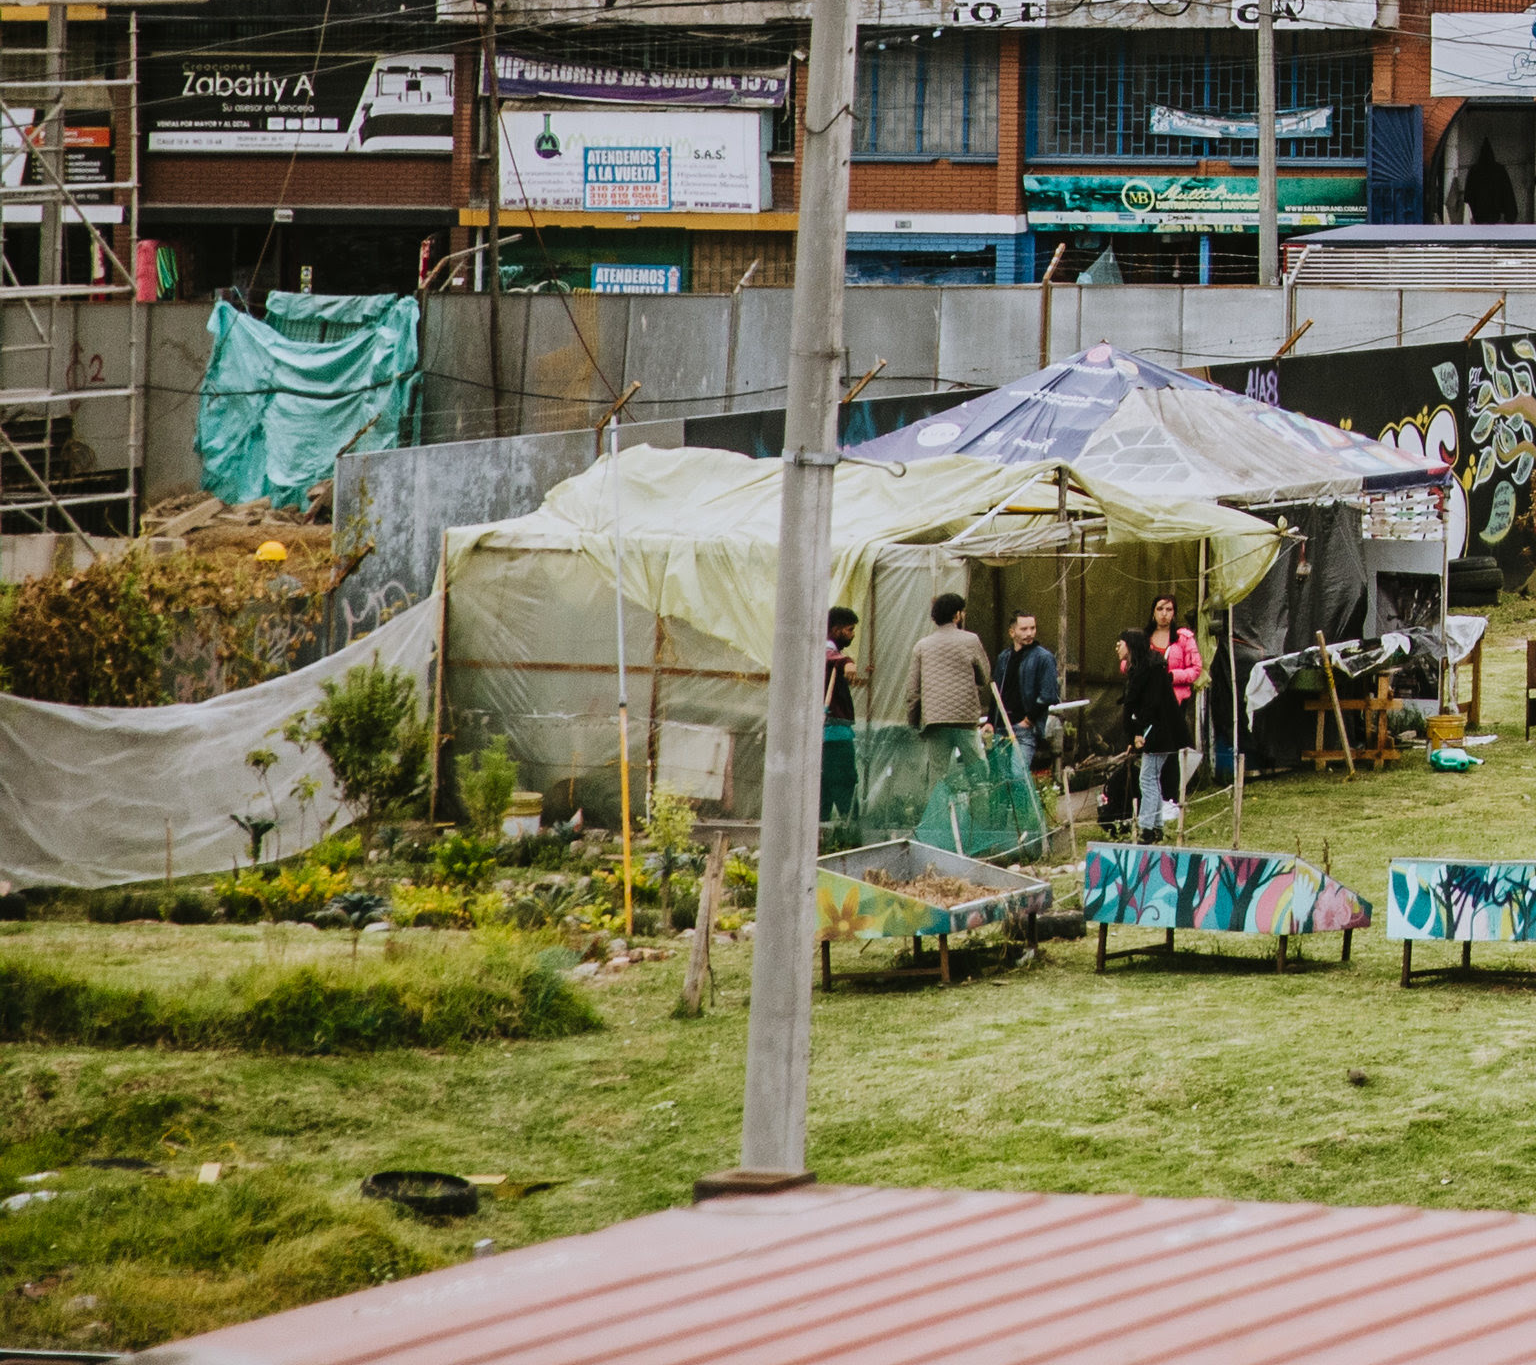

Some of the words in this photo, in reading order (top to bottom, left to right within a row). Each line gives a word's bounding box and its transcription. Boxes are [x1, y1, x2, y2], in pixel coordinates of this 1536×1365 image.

[182, 71, 288, 103] Zabatty
[292, 74, 315, 97] A
[222, 103, 232, 113] Su
[234, 104, 262, 113] asesor
[265, 104, 277, 113] en
[586, 149, 657, 166] ATENDEMOS
[693, 148, 726, 161] S.A.S.
[587, 166, 598, 182] A
[598, 166, 613, 182] LA
[614, 166, 657, 182] VUELTA
[595, 267, 666, 284] ATENDEMOS
